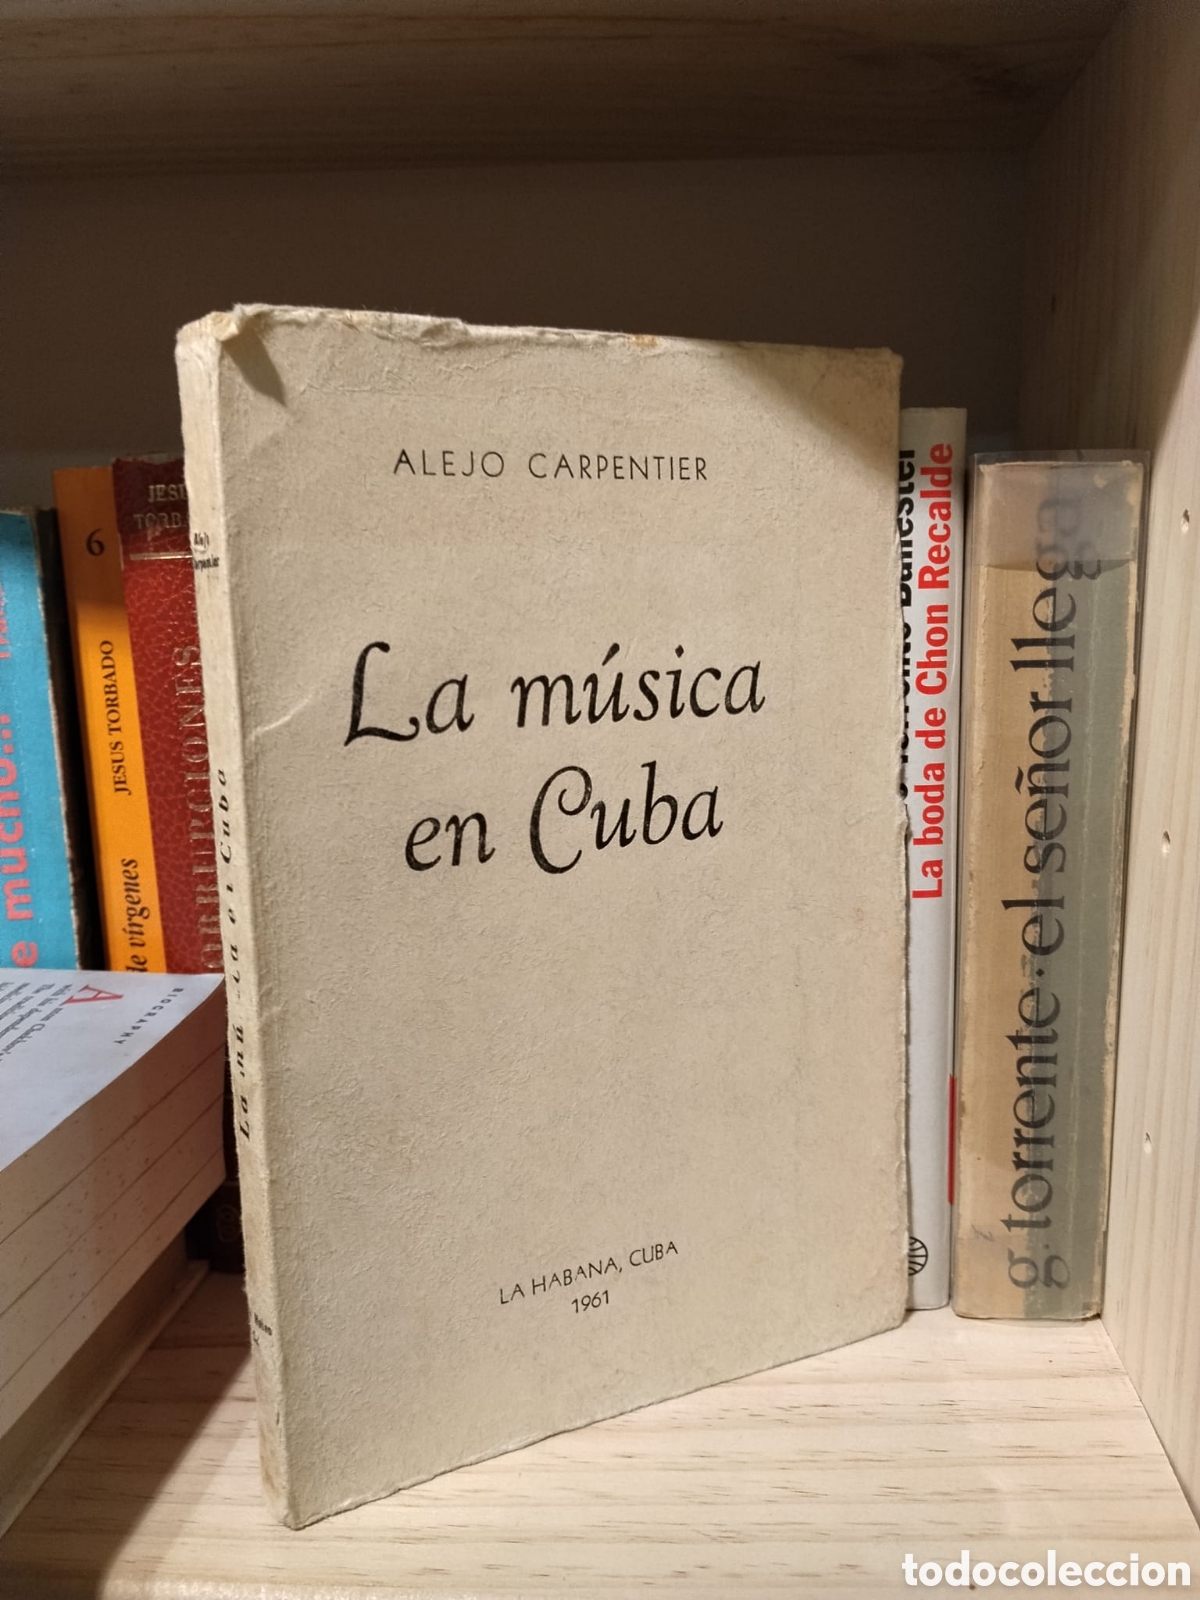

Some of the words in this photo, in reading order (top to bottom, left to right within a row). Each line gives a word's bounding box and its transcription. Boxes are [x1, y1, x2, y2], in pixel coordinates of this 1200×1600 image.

[394, 449, 505, 478] ALEJO
[528, 452, 707, 481] CARPENTIER
[86, 528, 105, 556] 6
[918, 443, 953, 589] Recalde
[915, 604, 949, 695] Chon
[99, 640, 123, 736] TORBADO
[344, 641, 475, 746] La
[511, 642, 765, 728] música
[915, 707, 947, 749] de
[109, 740, 132, 795] JESUS
[913, 762, 945, 845] boda
[1015, 691, 1073, 874] señor
[218, 769, 232, 864] Cuba
[405, 812, 495, 871] en
[530, 760, 723, 874] Cuba
[121, 858, 150, 947] vírgenes
[912, 859, 943, 898] La
[1001, 896, 1065, 956] el
[113, 987, 184, 1045] BIOGRAPHY
[500, 1283, 525, 1305] LA
[532, 1257, 623, 1296] HABANA,
[629, 1241, 679, 1267] CUBA
[571, 1289, 610, 1314] 1961
